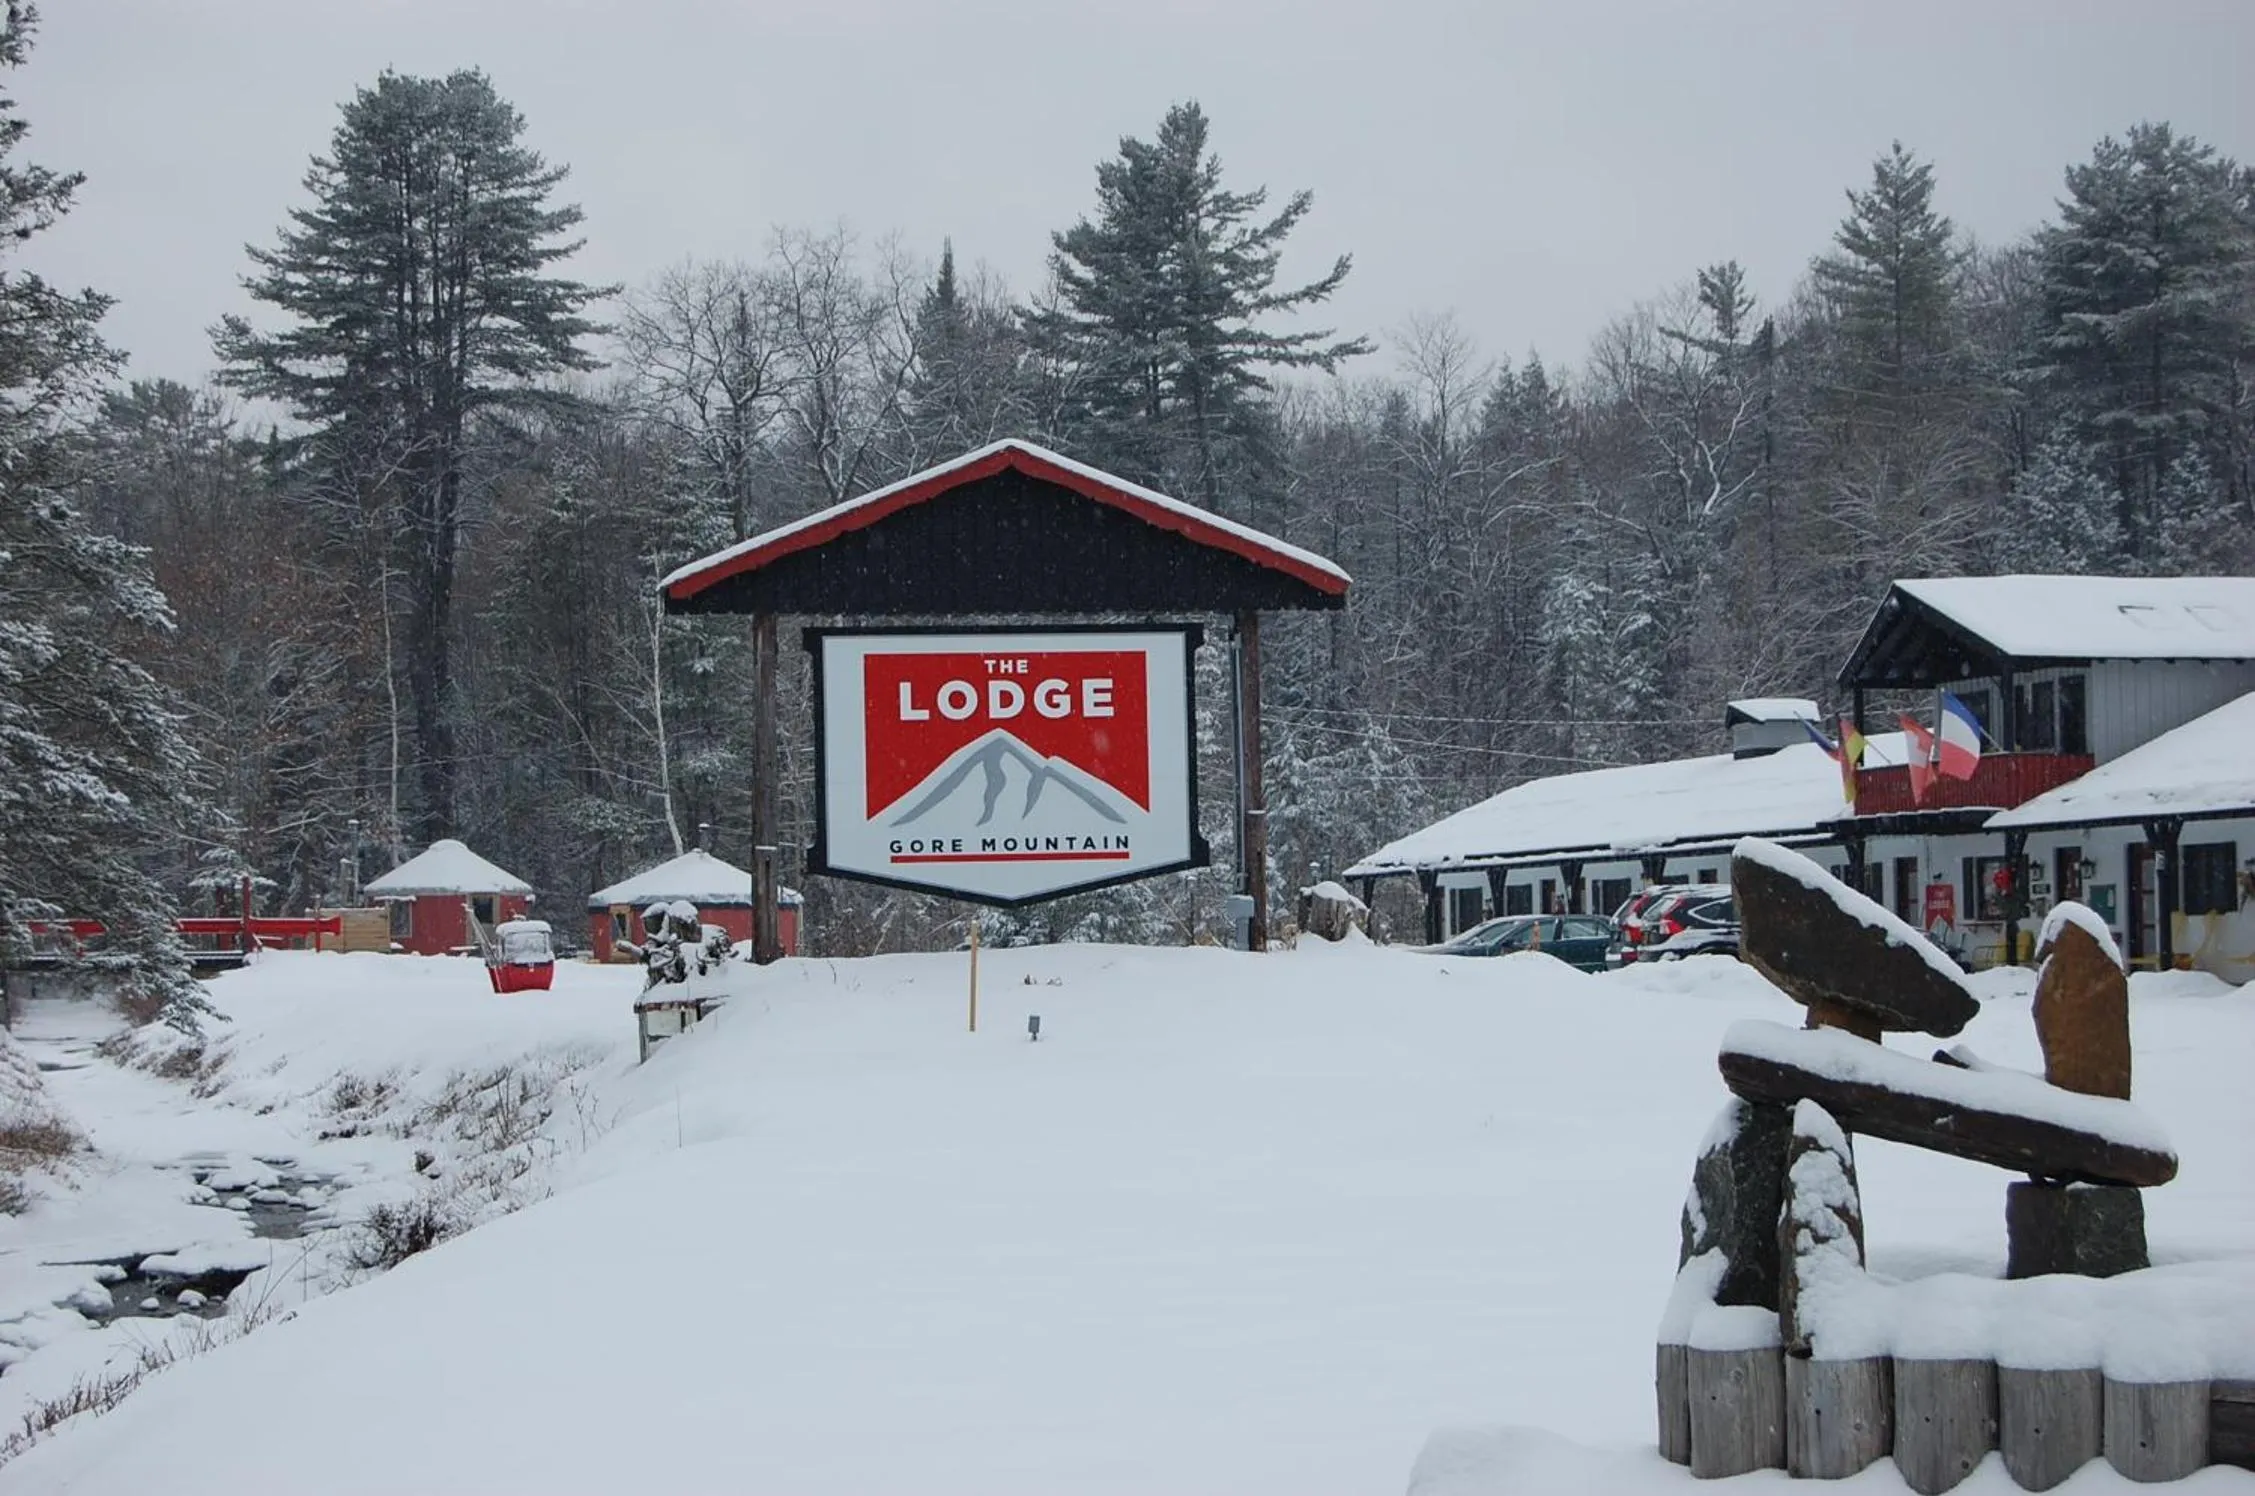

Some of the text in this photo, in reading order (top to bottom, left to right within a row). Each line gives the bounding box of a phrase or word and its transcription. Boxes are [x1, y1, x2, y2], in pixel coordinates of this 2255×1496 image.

[984, 659, 1029, 674] THE
[898, 678, 1115, 721] LODGE
[889, 835, 1130, 853] GORE MOUNTAIN
